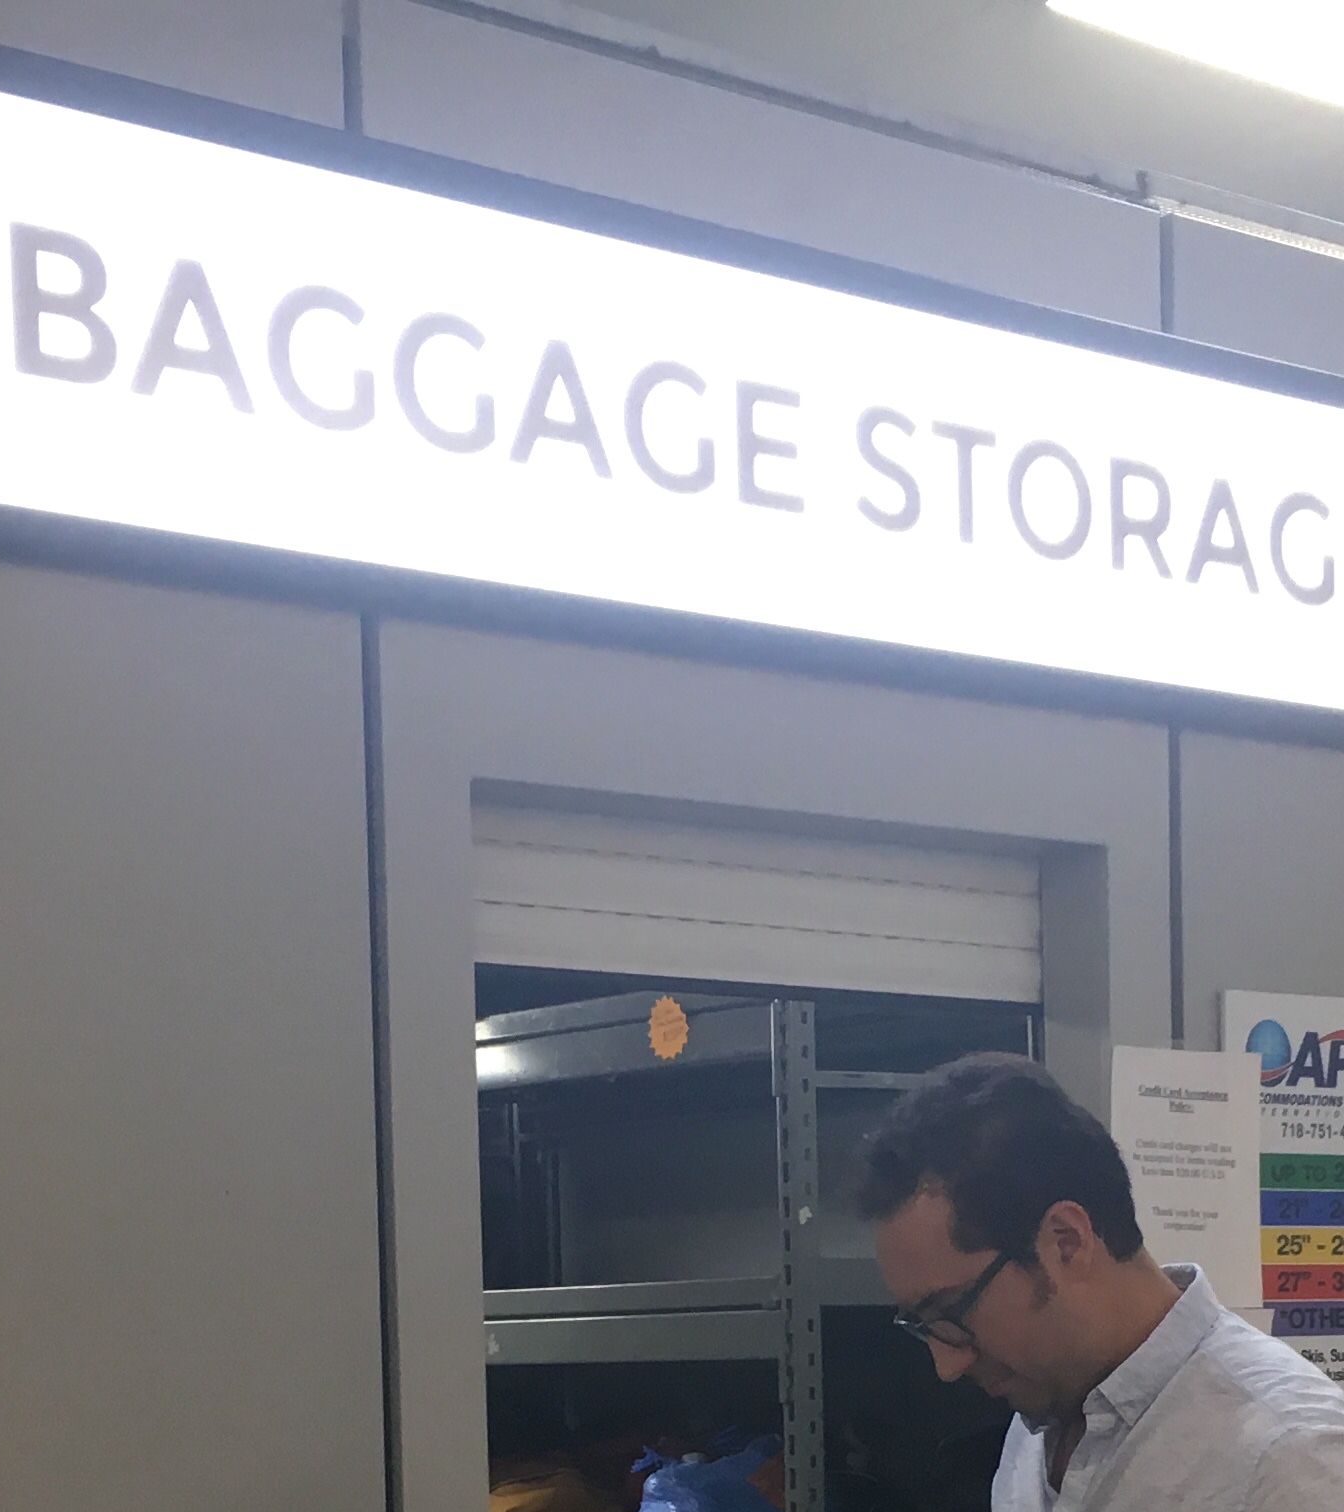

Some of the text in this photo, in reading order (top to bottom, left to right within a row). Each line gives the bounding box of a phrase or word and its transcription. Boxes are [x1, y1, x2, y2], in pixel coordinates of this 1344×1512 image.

[9, 219, 805, 514] BAGGAGE
[1270, 1163, 1296, 1182] UP
[1304, 1164, 1326, 1182] TO
[1276, 1234, 1311, 1256] 25"
[1277, 1271, 1312, 1292] 27"
